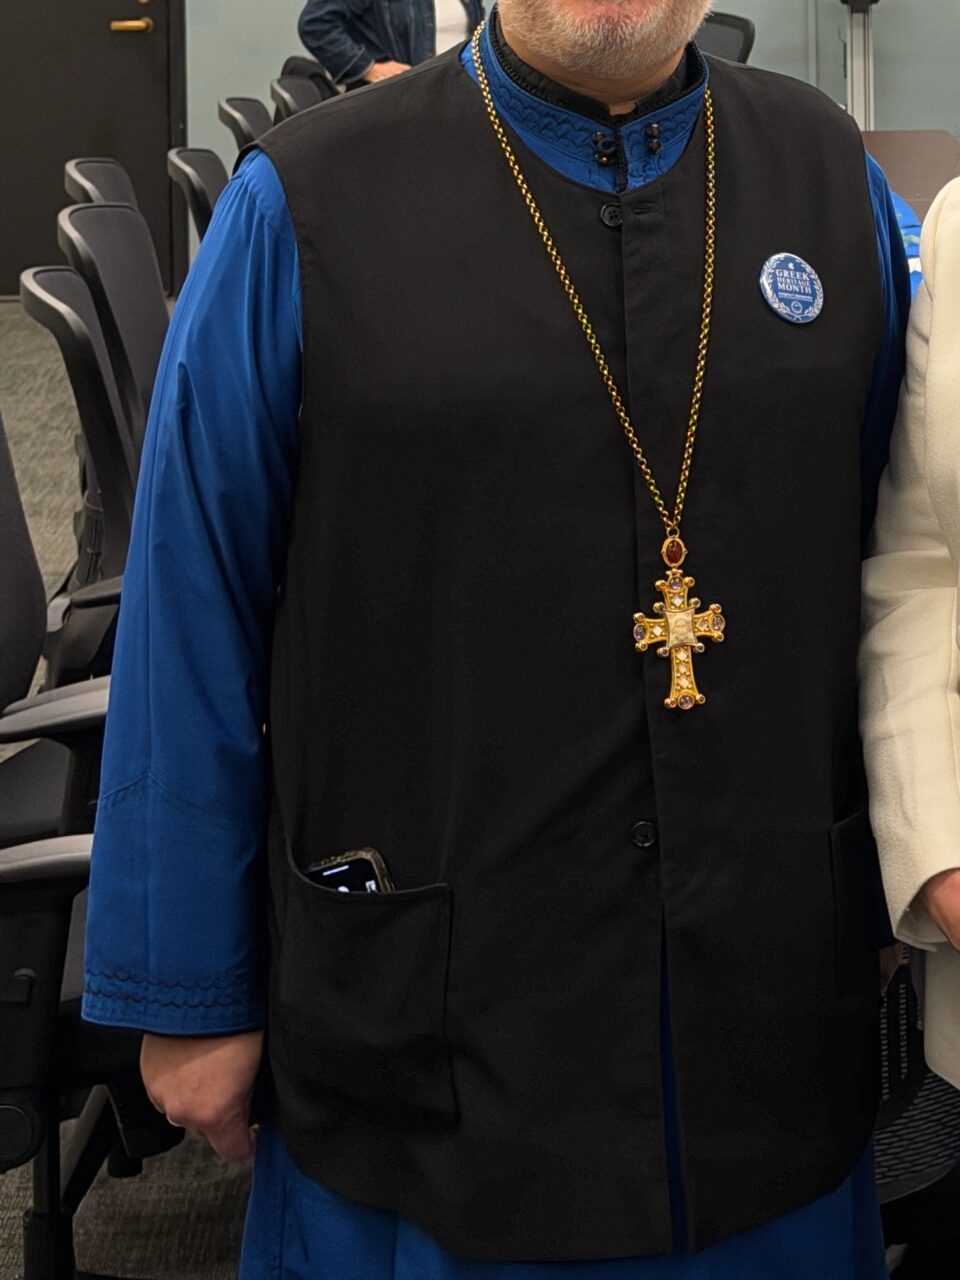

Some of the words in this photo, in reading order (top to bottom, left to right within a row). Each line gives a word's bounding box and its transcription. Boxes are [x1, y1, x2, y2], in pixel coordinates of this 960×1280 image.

[776, 269, 810, 281] GREEK
[777, 277, 811, 287] HERITAGE
[777, 283, 812, 295] MONTH
